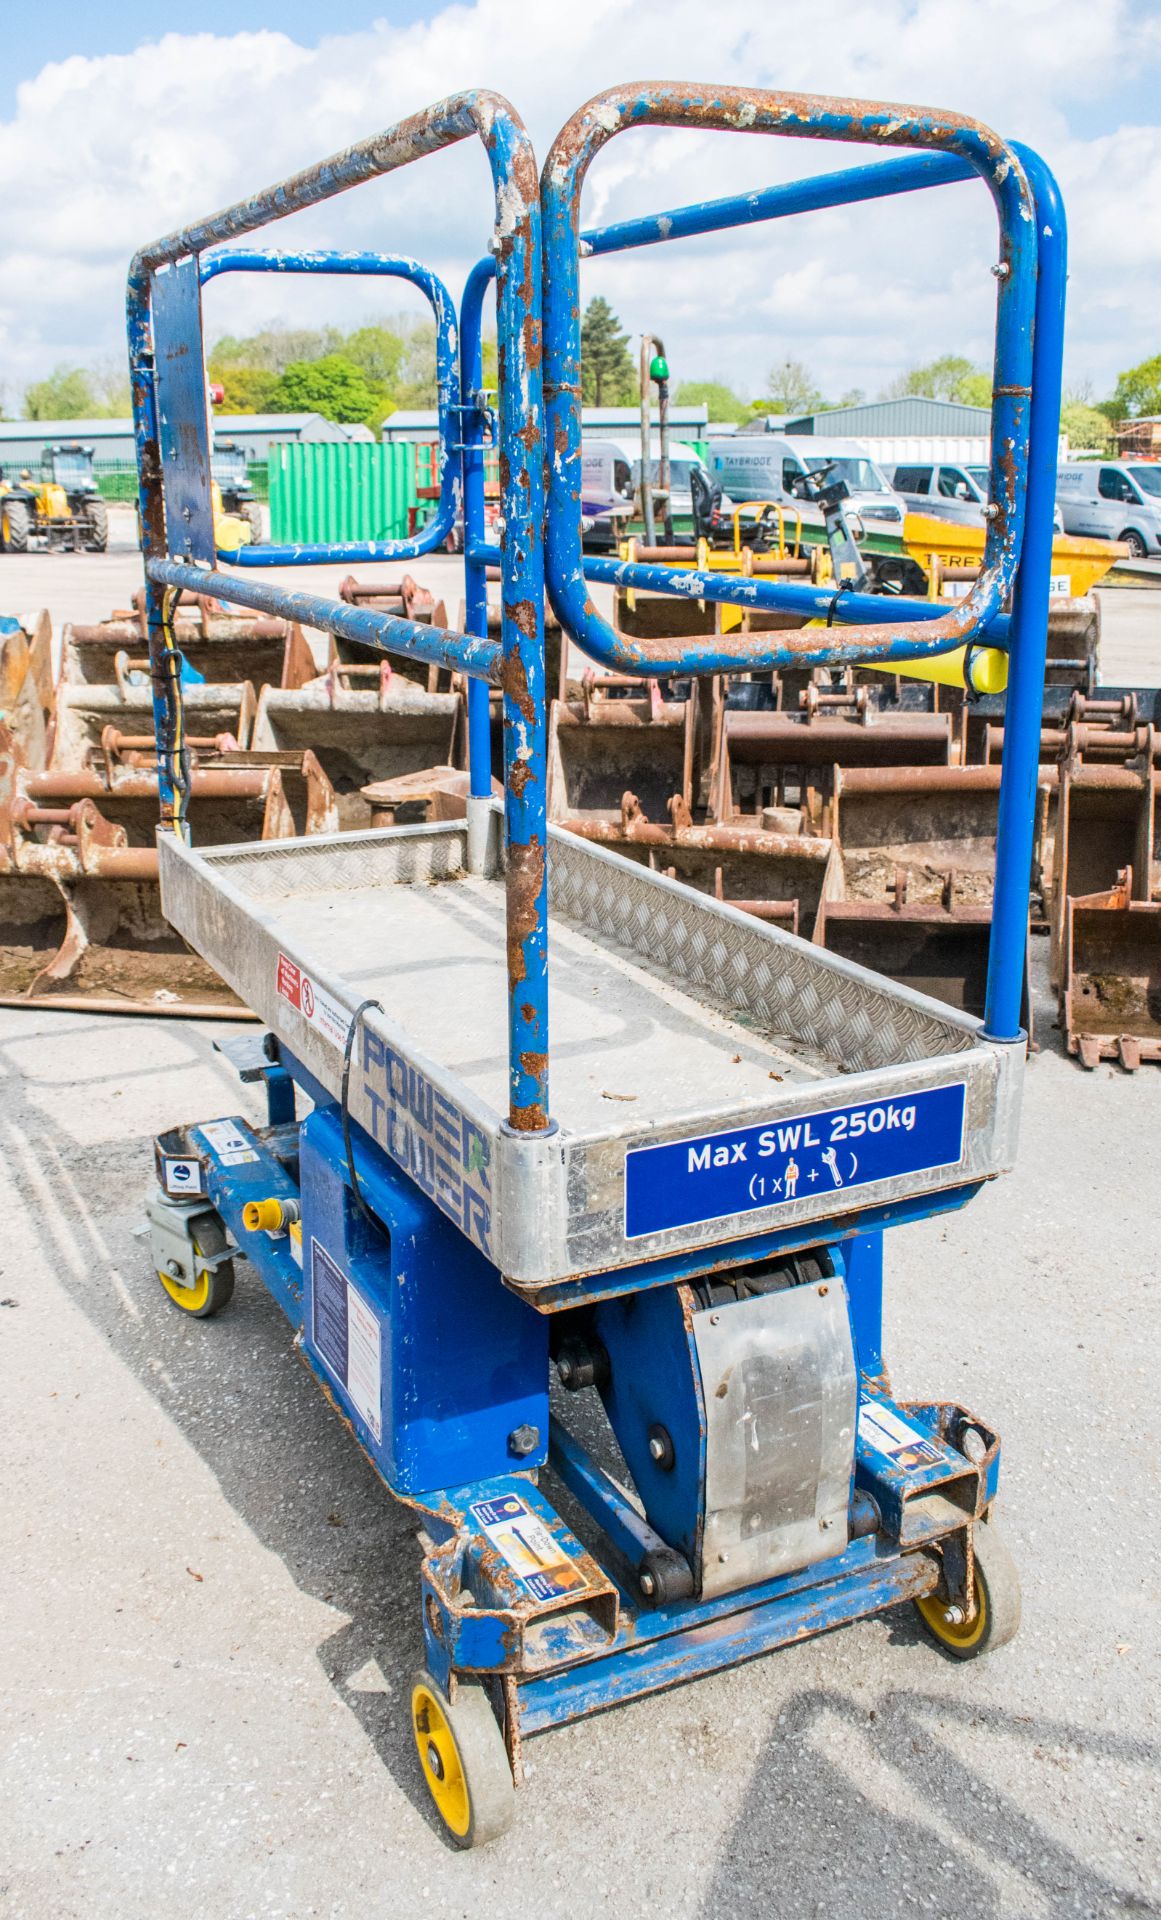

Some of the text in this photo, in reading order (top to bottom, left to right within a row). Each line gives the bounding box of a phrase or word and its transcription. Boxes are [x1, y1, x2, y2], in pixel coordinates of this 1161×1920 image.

[725, 457, 772, 465] TAYBRIDGE
[364, 1026, 491, 1193] POWER
[687, 1105, 916, 1173] Max SWL 250kg
[364, 1083, 491, 1256] TOWER
